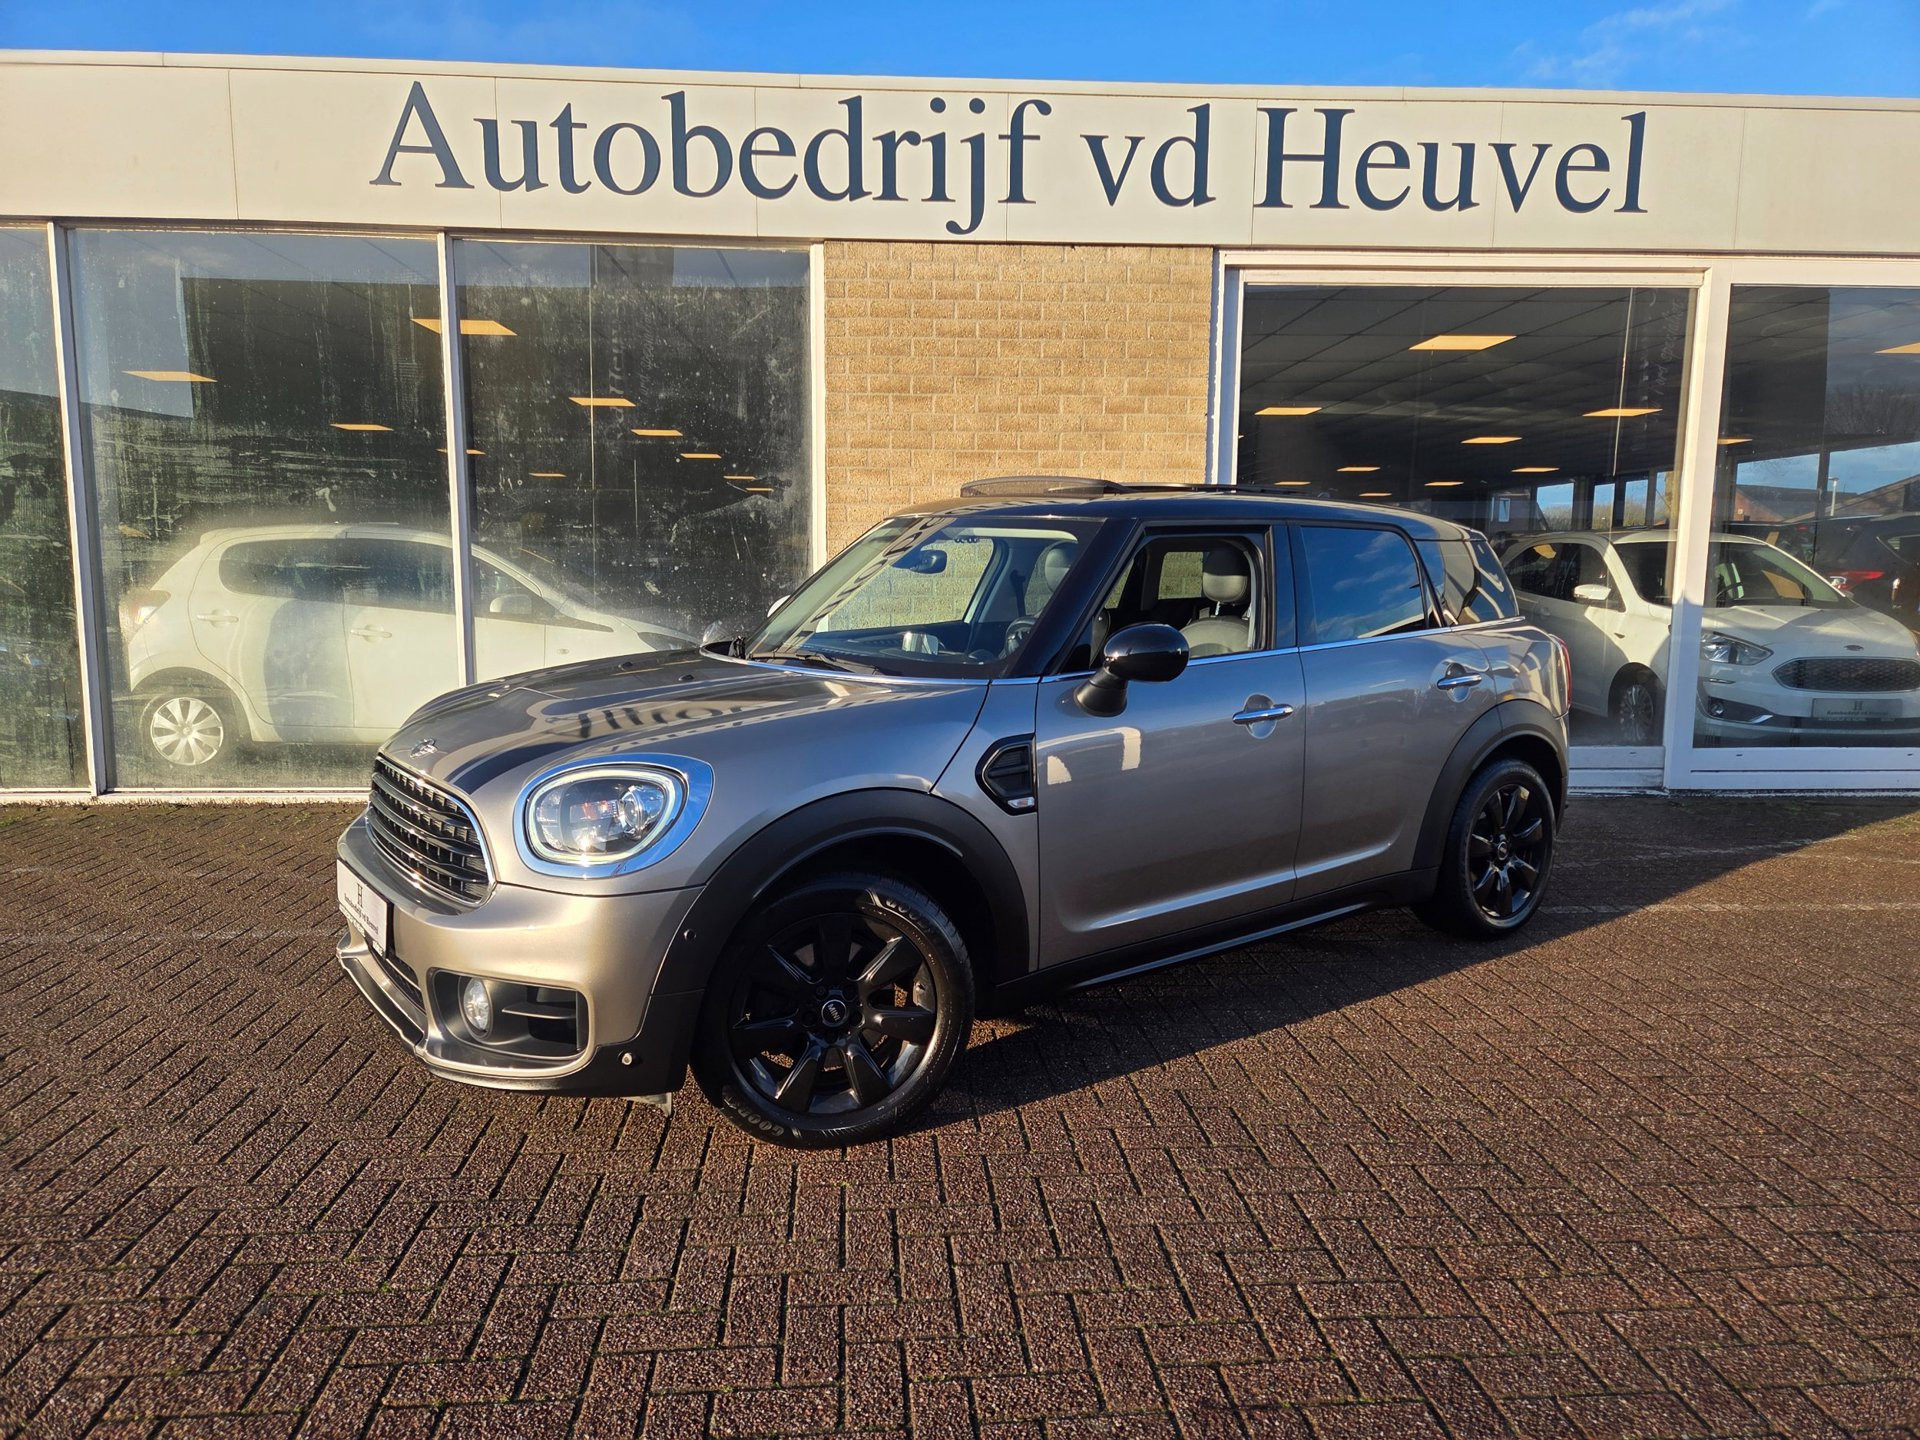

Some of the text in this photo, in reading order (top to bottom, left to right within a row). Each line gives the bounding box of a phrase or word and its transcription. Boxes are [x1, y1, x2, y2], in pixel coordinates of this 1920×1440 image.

[369, 80, 1648, 235] Autobedrijf vd Heuvel
